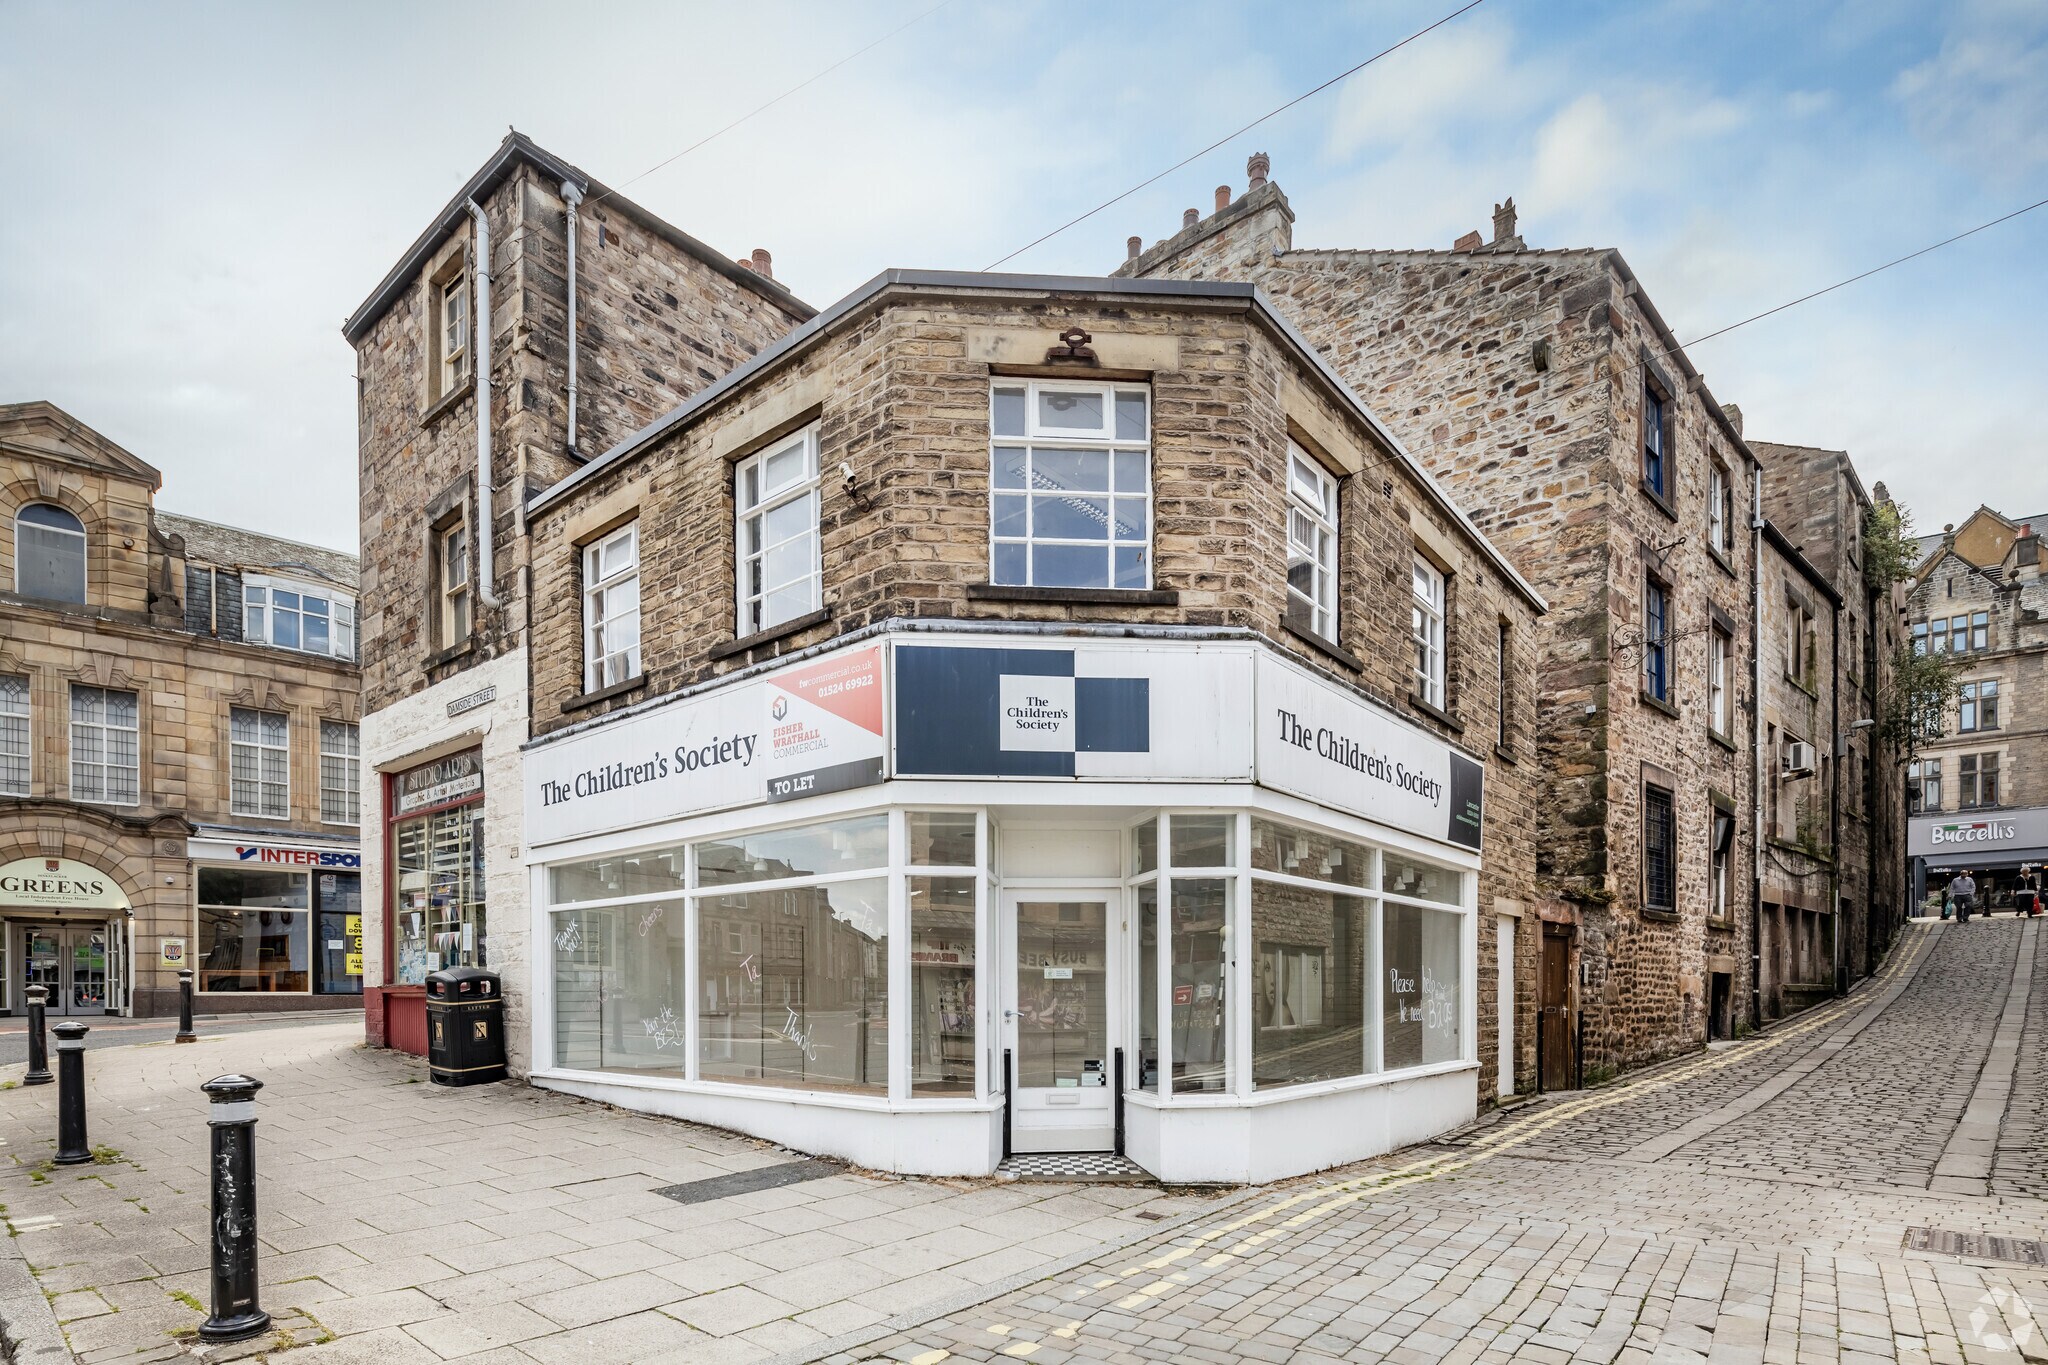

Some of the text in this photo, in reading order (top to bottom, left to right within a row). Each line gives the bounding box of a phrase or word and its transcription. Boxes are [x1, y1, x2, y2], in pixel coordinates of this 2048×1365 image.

[799, 660, 873, 689] fwcommercial.co.uk
[818, 674, 873, 698] 01524 69922
[448, 688, 495, 715] DAMSIDE STREET
[1007, 707, 1068, 719] Children's
[1026, 696, 1049, 707] The
[773, 721, 804, 738] FISHER
[1016, 719, 1060, 732] Society
[773, 729, 820, 749] WRATHALL
[773, 738, 829, 760] COMMERCIAL
[541, 733, 758, 807] The Children's Society
[1277, 708, 1442, 808] The Children's Society
[408, 752, 472, 791] STUDIO ARTS
[405, 777, 475, 807] Graphic & Artist Materials
[774, 774, 815, 795] TO LET
[261, 848, 361, 868] INTERSPO
[0, 876, 104, 896] GREENS
[639, 904, 663, 937] Cheers
[1554, 924, 1560, 933] 2
[554, 918, 578, 952] THANK
[740, 954, 762, 982] Ta
[1389, 968, 1416, 994] Please
[1421, 964, 1436, 1000] help
[660, 1003, 674, 1024] the
[1410, 999, 1425, 1022] need
[653, 1016, 681, 1050] BEST
[782, 1006, 817, 1062] Thanks
